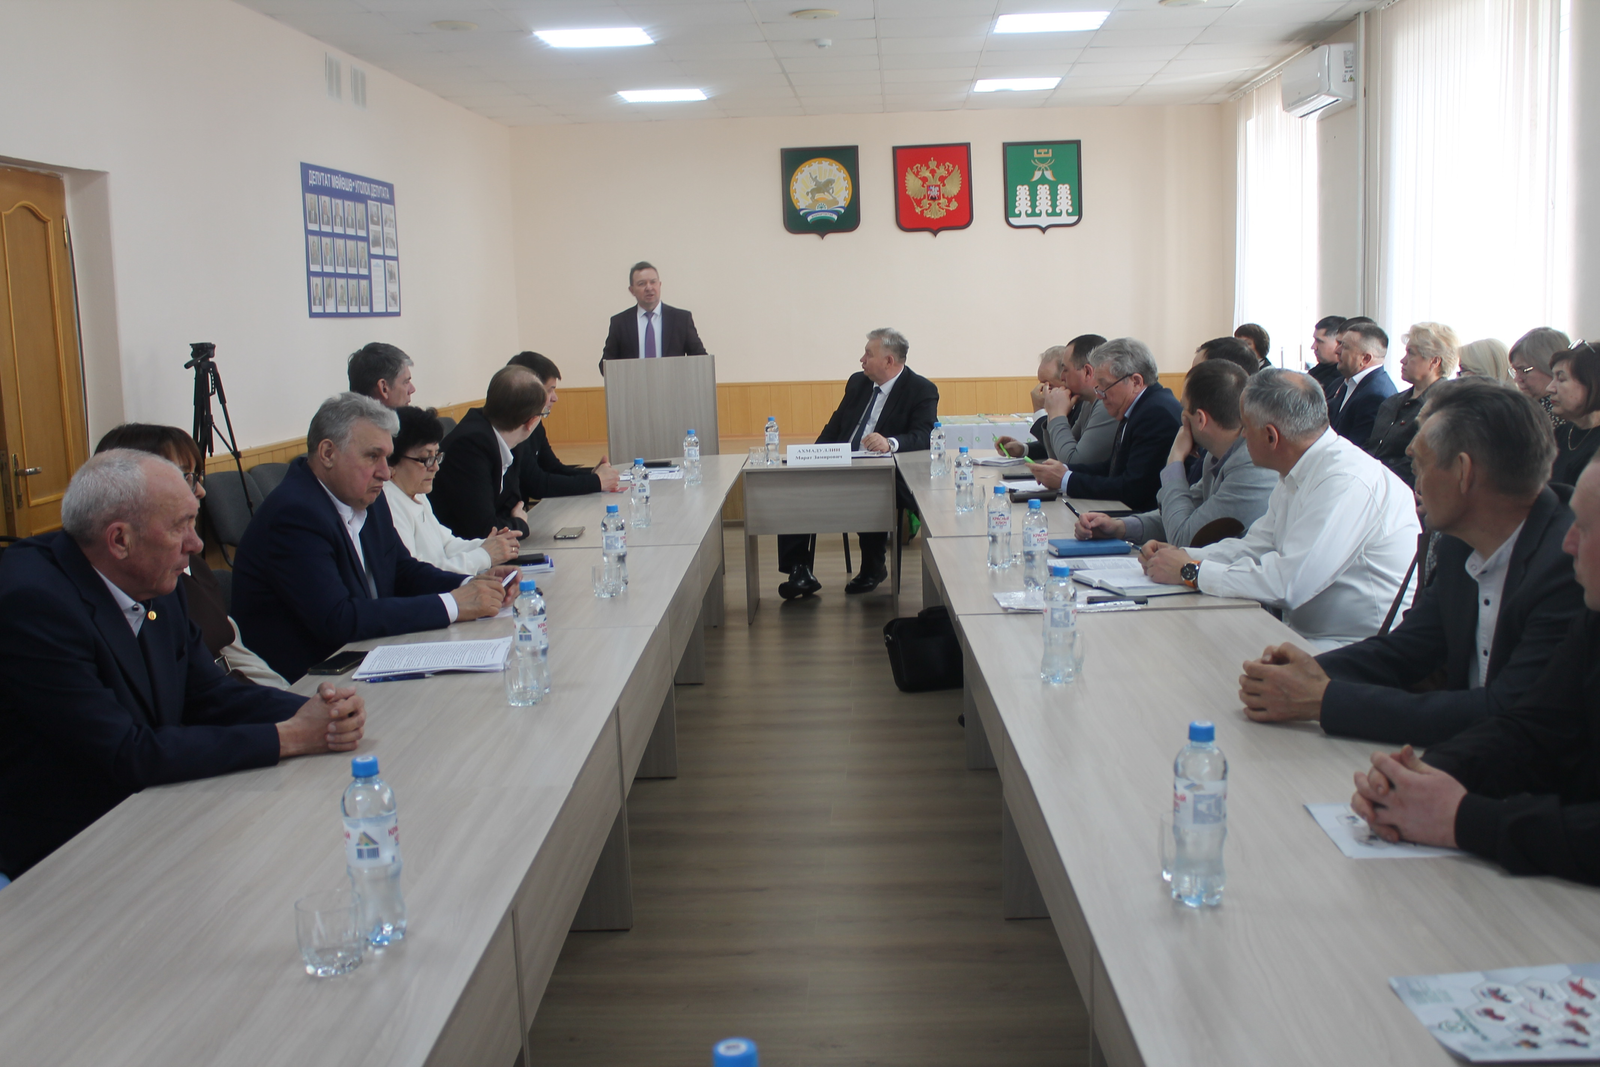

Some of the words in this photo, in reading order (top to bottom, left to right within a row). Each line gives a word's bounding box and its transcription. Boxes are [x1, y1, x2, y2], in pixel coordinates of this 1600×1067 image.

[308, 170, 331, 187] ДЕПУТАТ
[354, 180, 371, 196] УГОЛОК
[370, 184, 390, 199] ДЕПУТАТА
